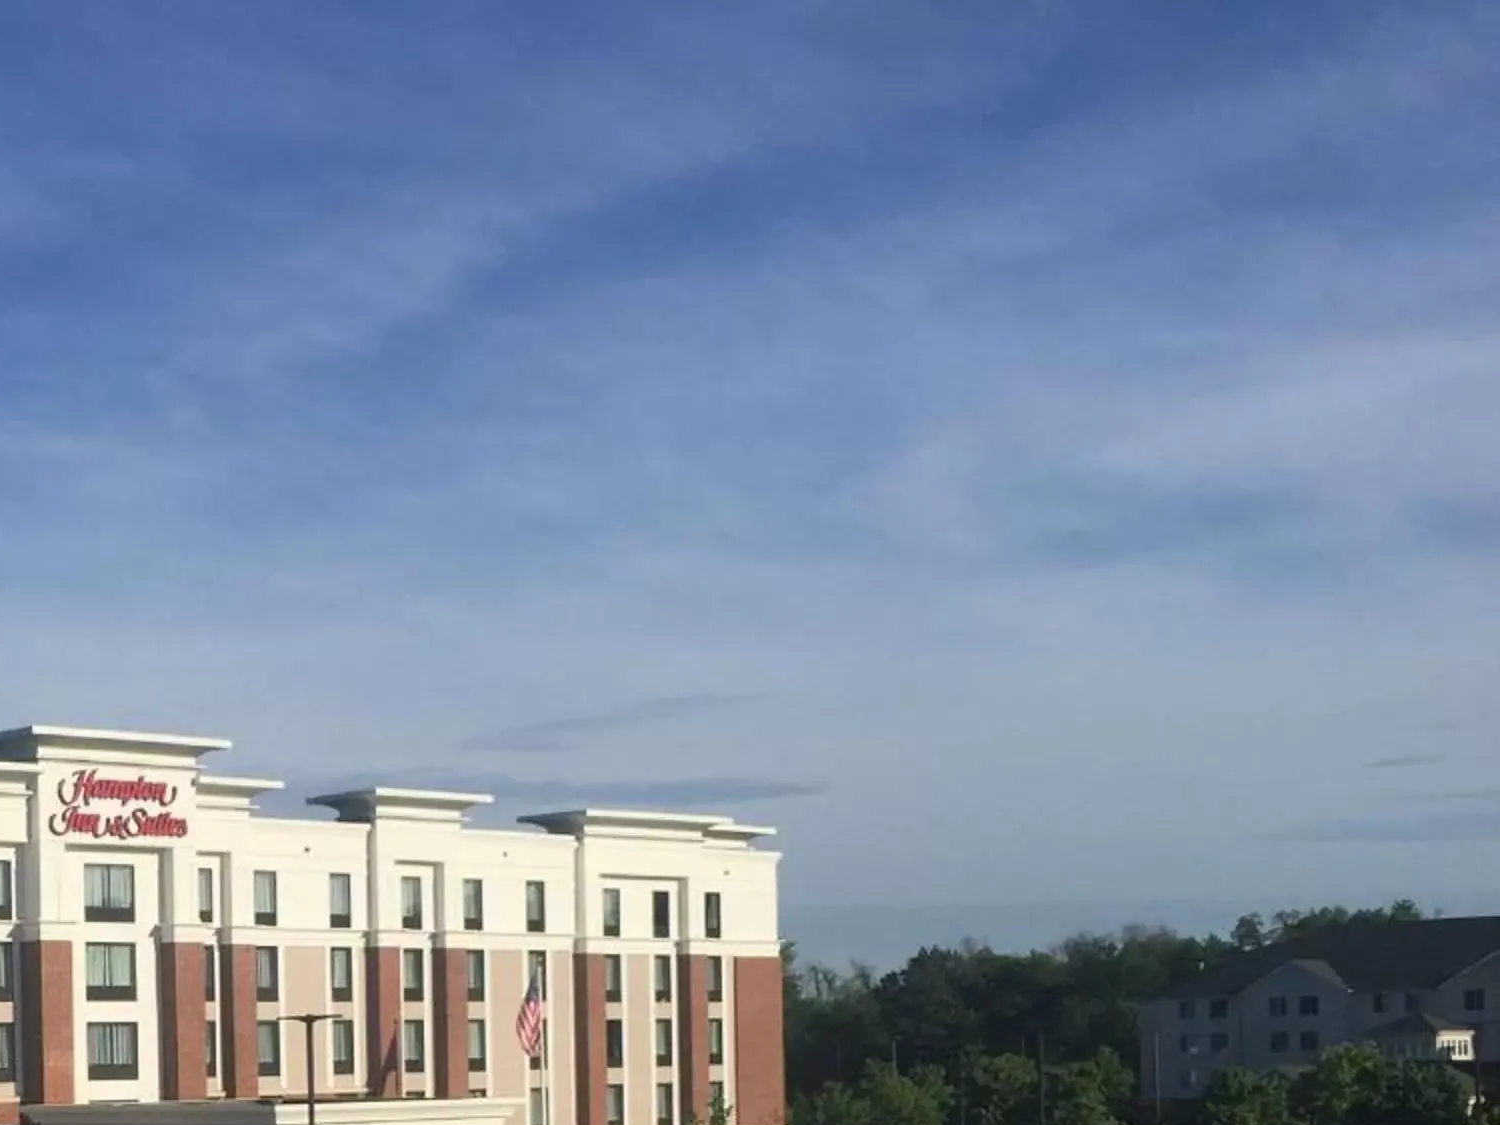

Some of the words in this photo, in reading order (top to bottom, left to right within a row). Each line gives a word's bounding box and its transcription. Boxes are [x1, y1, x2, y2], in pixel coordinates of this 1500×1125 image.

[58, 769, 176, 806] Hampton
[49, 806, 111, 838] Inn
[123, 808, 188, 838] Suites
